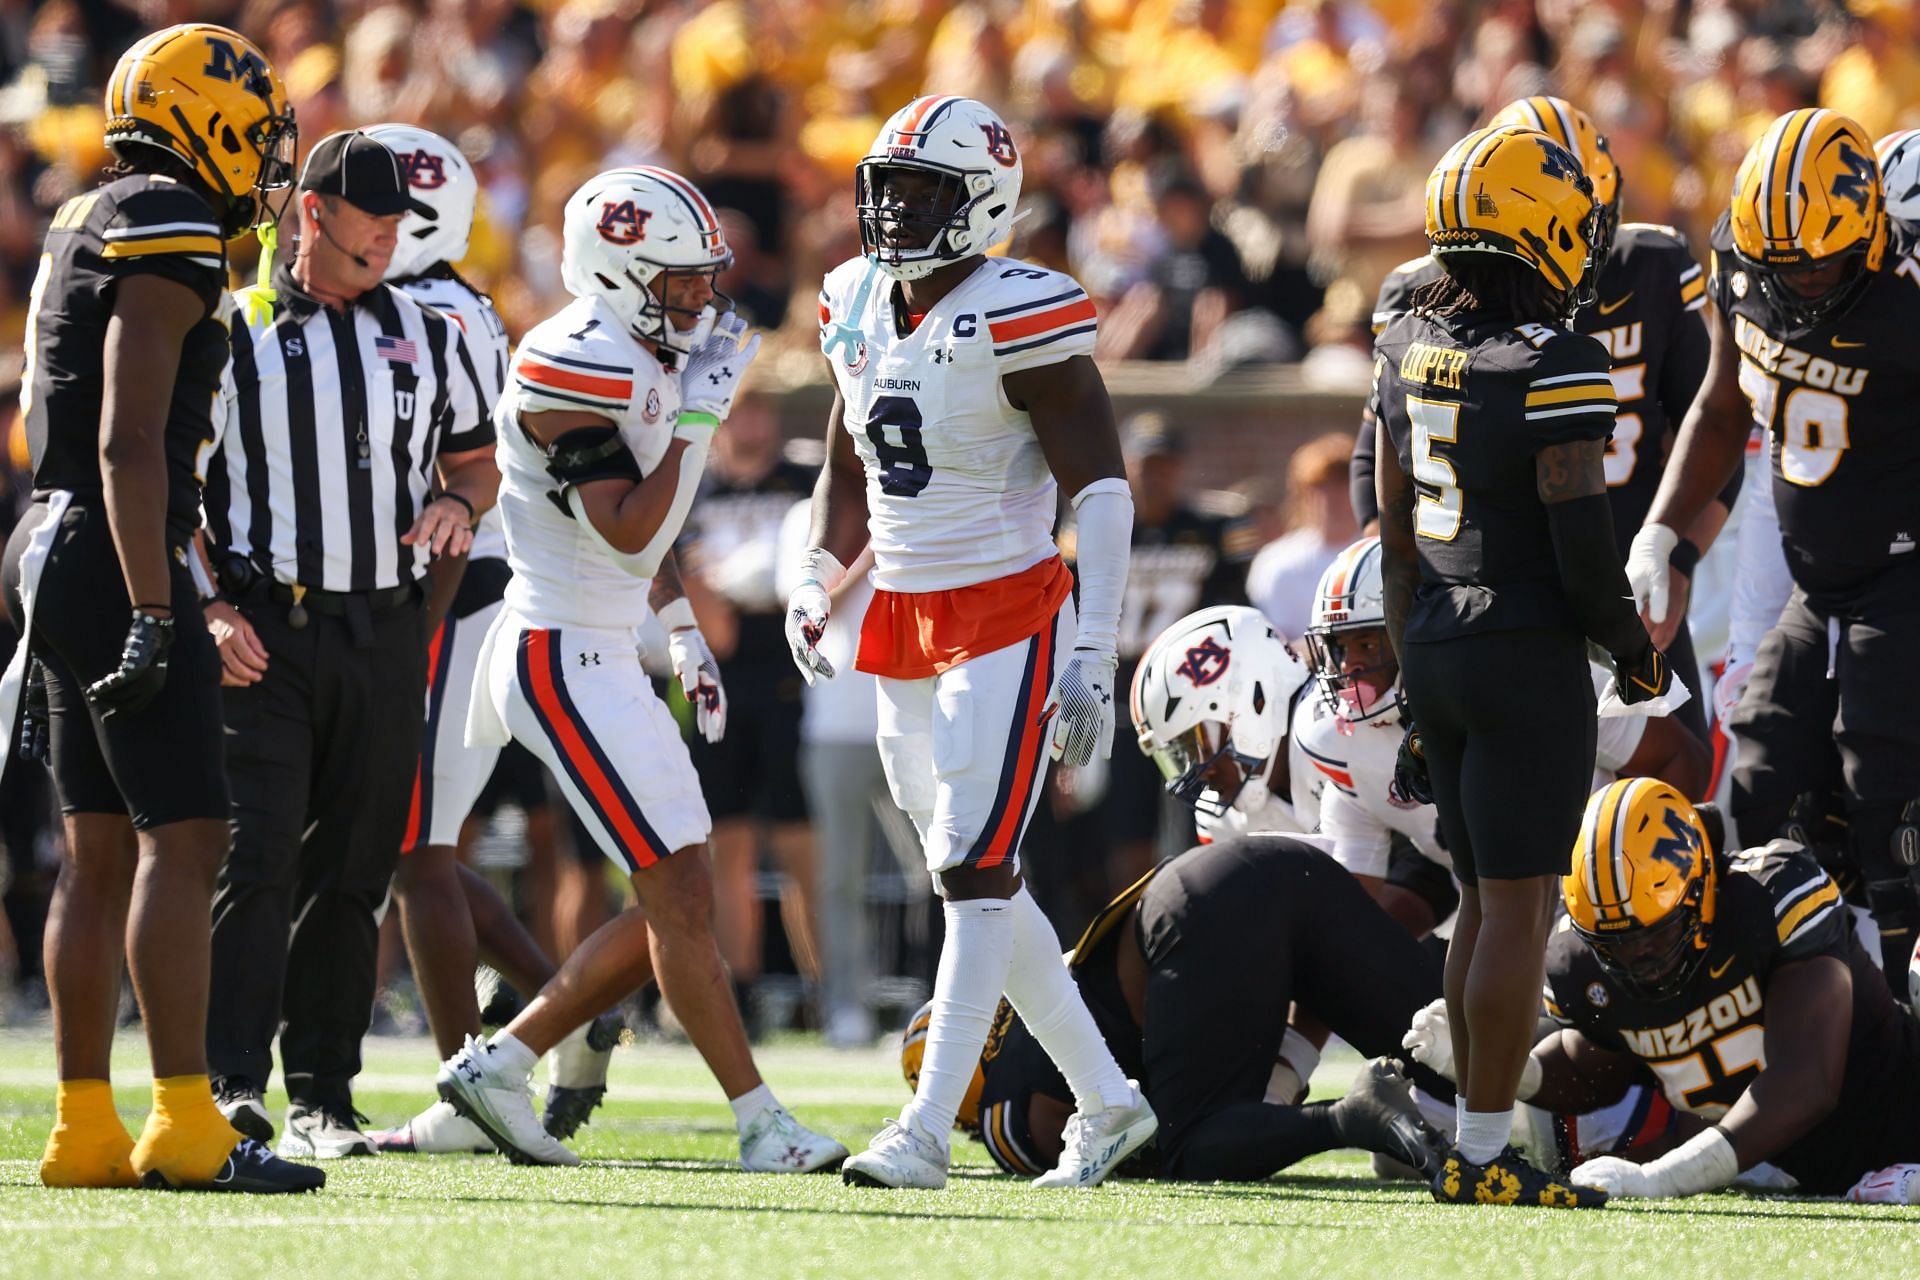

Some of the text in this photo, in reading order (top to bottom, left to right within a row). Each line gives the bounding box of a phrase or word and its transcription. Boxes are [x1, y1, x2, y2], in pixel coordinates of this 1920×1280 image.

[886, 147, 917, 158] TIGERS
[1768, 255, 1800, 263] MIZZOU
[952, 313, 977, 338] C
[1400, 342, 1468, 390] COOPER
[1735, 313, 1870, 396] MIZZOU
[872, 378, 922, 392] AUBURN
[395, 390, 415, 421] U
[1738, 352, 1851, 488] 70
[1405, 393, 1463, 541] 5
[1618, 974, 1763, 1059] MIZZOU
